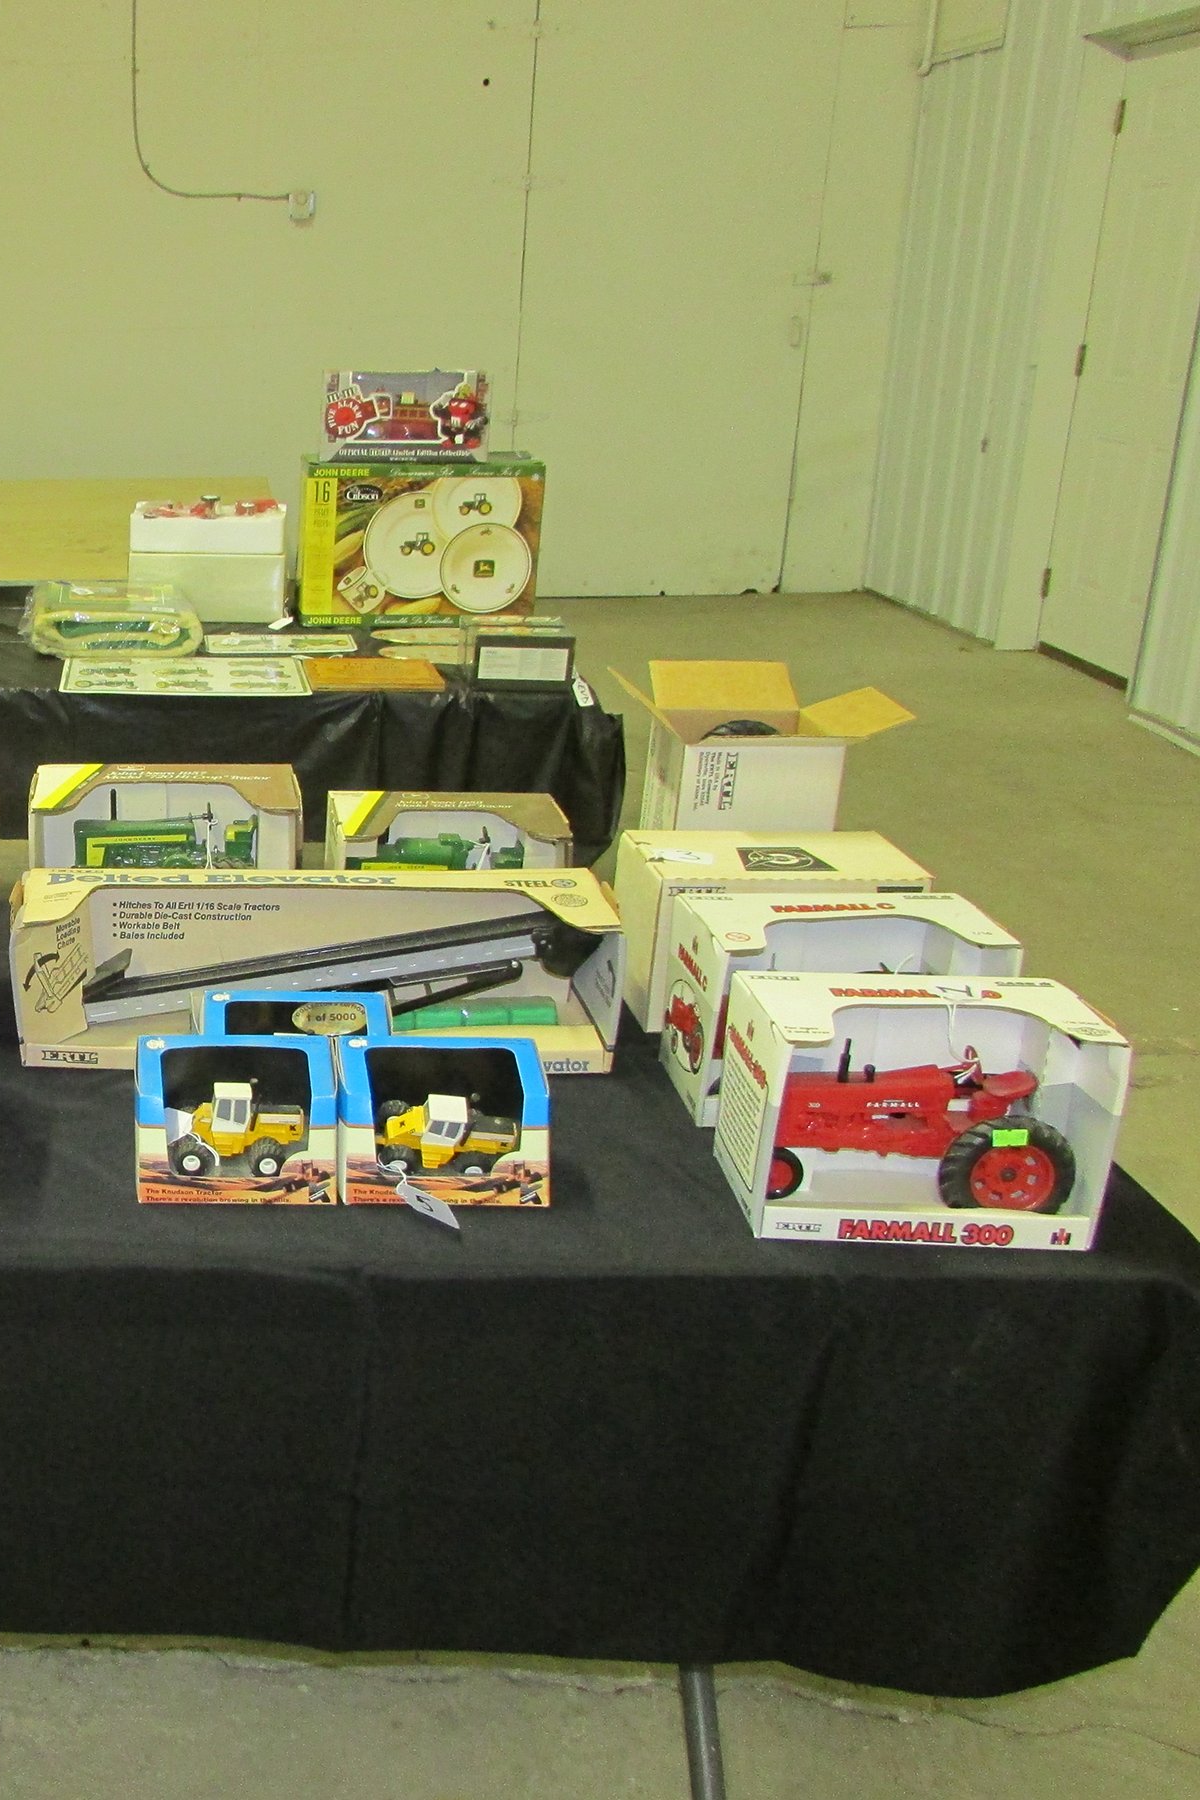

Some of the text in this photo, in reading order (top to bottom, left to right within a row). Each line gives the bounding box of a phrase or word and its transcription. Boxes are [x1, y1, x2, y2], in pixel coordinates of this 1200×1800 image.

[328, 400, 363, 435] FIVE ALARM FUN
[314, 468, 370, 477] JOHN DEERE
[314, 481, 331, 502] 16
[346, 489, 379, 501] Gibson
[307, 616, 362, 625] JOHN DEERE
[718, 752, 739, 811] ERTL
[46, 873, 397, 886] Belted Elevator
[504, 879, 553, 888] STEEL
[118, 901, 281, 912] Hitches To All Ertl 1/16 Scale Tractors
[770, 902, 897, 914] FARMALL C
[119, 911, 252, 921] Durable Die-Cast Construction
[56, 917, 81, 933] Movable
[119, 921, 181, 931] Workable Belt
[56, 926, 81, 942] Loading
[119, 931, 185, 940] Bales Included
[56, 936, 76, 950] Chute
[678, 943, 703, 988] FARMALL
[829, 987, 941, 999] FARMAL
[315, 1013, 326, 1022] of
[328, 1012, 357, 1021] 5000
[41, 1050, 99, 1065] ERTL
[542, 1057, 590, 1072] vator
[195, 1189, 224, 1197] Tractor
[415, 1194, 435, 1213] 5
[775, 1220, 823, 1233] ERTL
[837, 1218, 958, 1243] FARMALL
[959, 1222, 1015, 1246] 300
